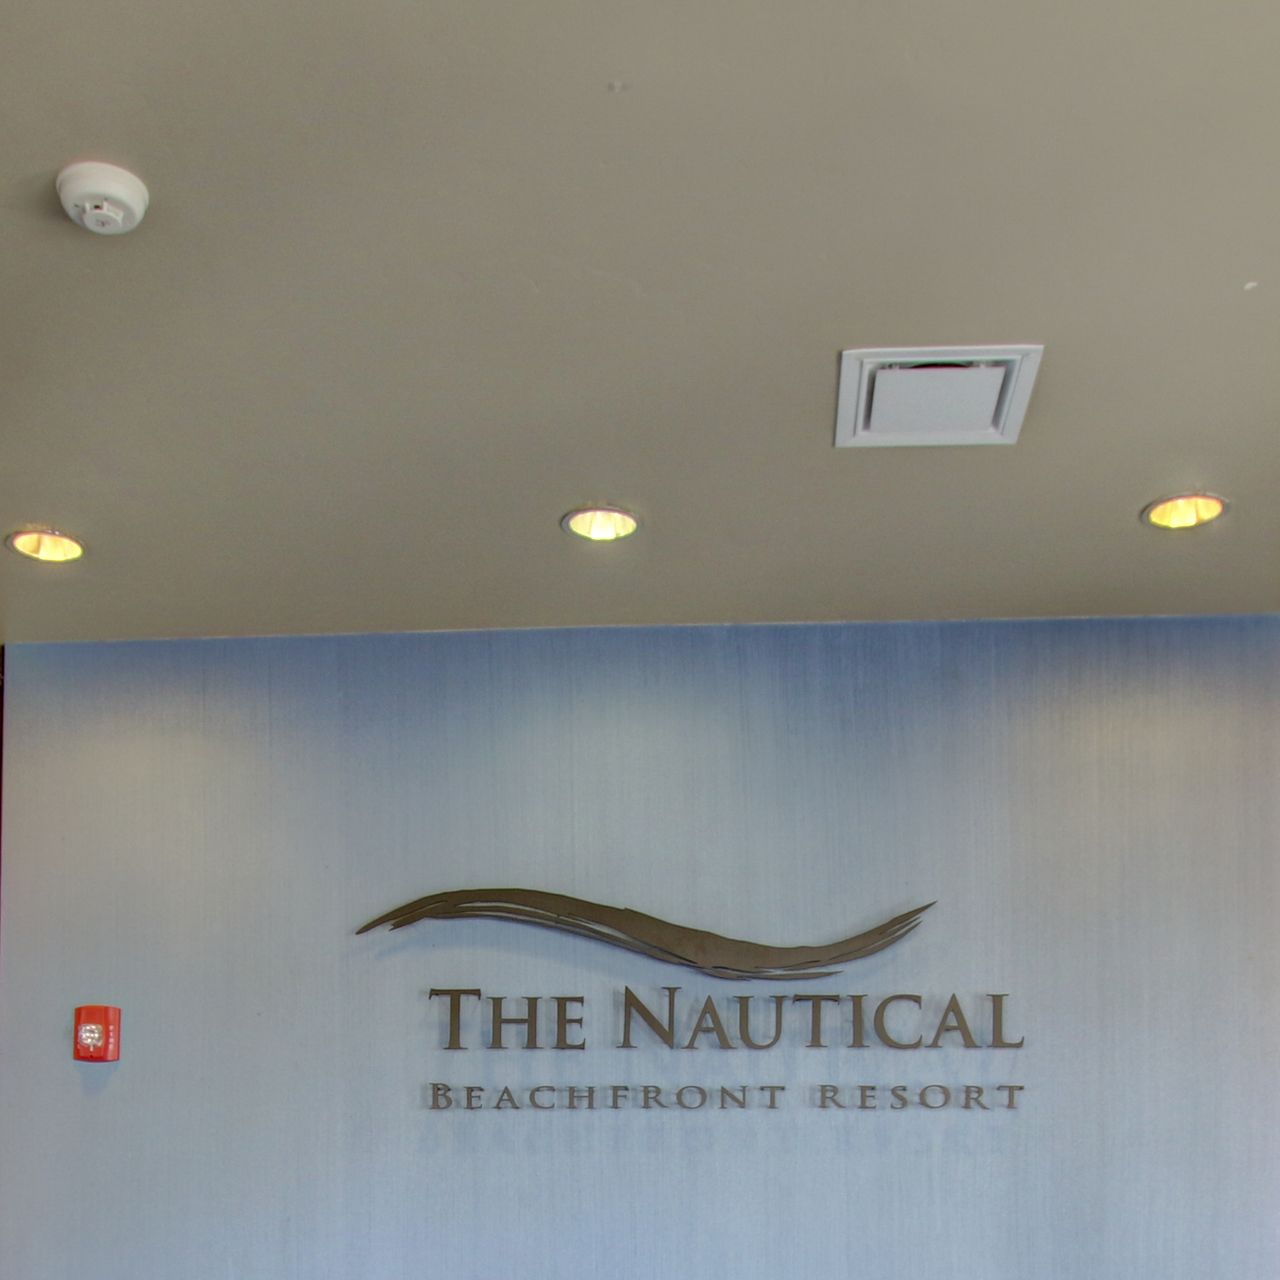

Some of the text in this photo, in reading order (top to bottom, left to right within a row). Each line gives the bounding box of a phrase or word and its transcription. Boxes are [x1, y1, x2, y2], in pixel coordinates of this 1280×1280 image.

[429, 985, 1025, 1051] THE NAUTICAL
[429, 1082, 1025, 1111] BEACHFRONT RESORT
